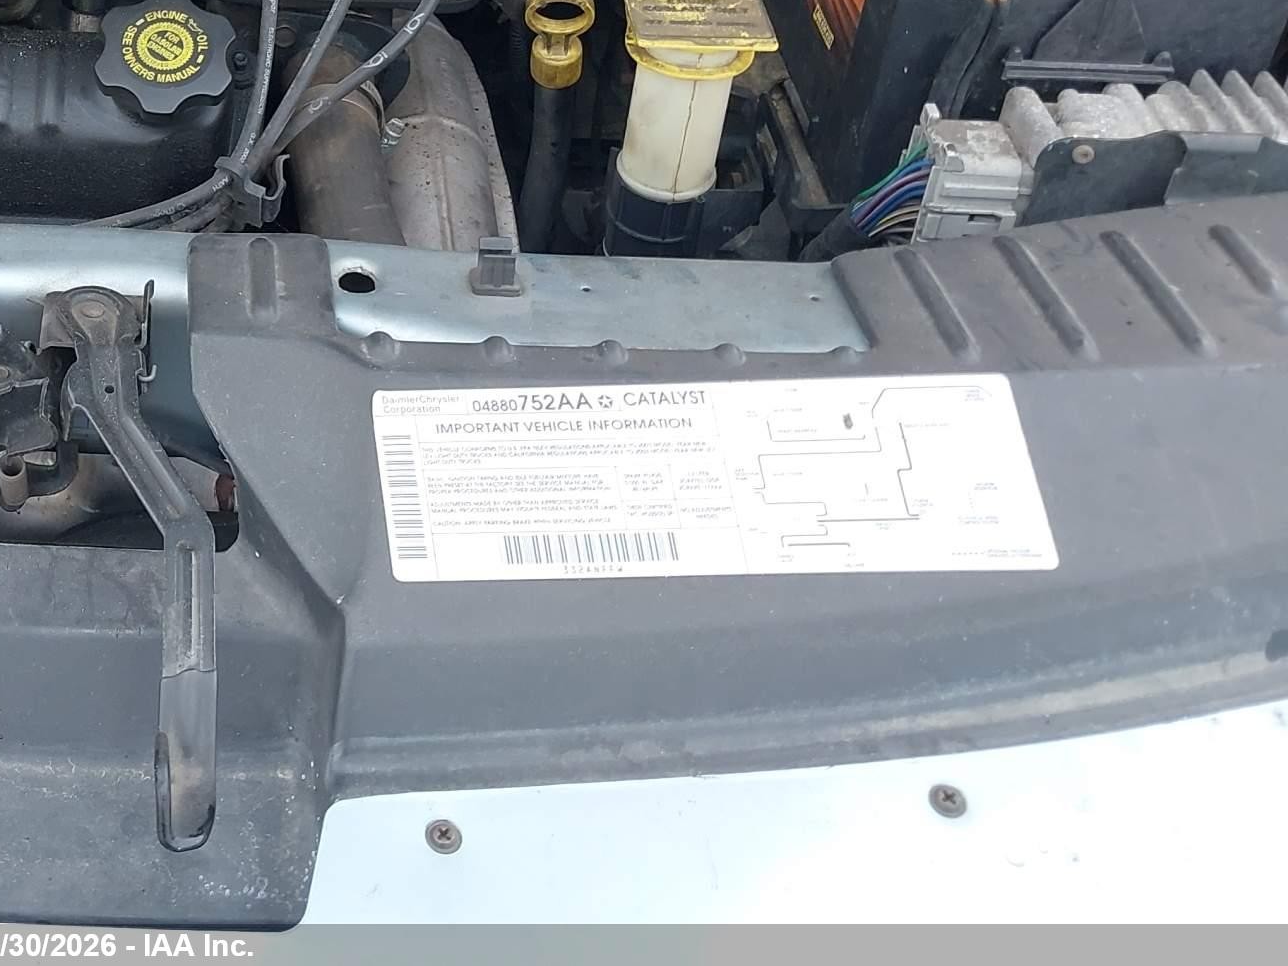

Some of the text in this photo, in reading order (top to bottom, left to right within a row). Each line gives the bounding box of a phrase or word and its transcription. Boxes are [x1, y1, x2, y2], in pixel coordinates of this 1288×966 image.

[145, 10, 209, 52] ENGINE OIL
[164, 32, 181, 44] FOR
[122, 25, 201, 83] SEE OWNERS MANUAL
[382, 394, 460, 406] DaimlerChrysler
[472, 392, 594, 412] 04880752AA
[623, 390, 706, 407] CATALYST
[383, 404, 442, 414] Corporation
[435, 417, 693, 434] IMPORTANT VEHICLE INFORMATION
